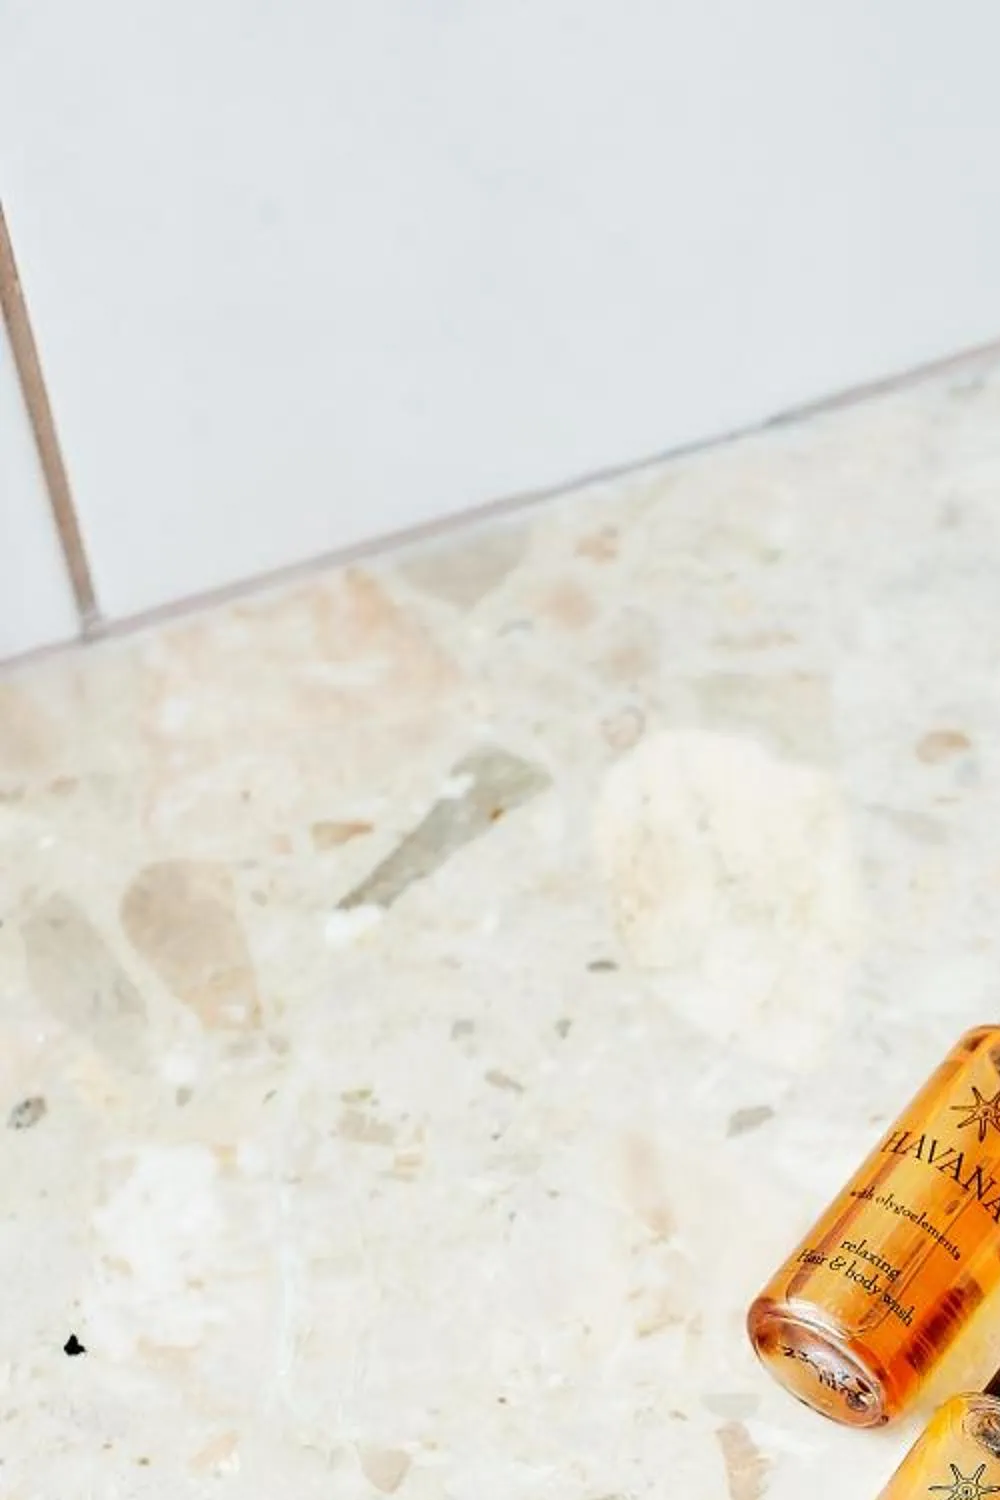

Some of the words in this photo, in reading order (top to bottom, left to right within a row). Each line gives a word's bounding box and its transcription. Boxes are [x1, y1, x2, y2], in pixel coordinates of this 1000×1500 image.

[840, 1240, 901, 1282] relaxing
[875, 1194, 961, 1261] olygoelements
[797, 1248, 828, 1265] Hair
[829, 1255, 846, 1271] &
[845, 1259, 881, 1296] body
[881, 1291, 915, 1327] wash
